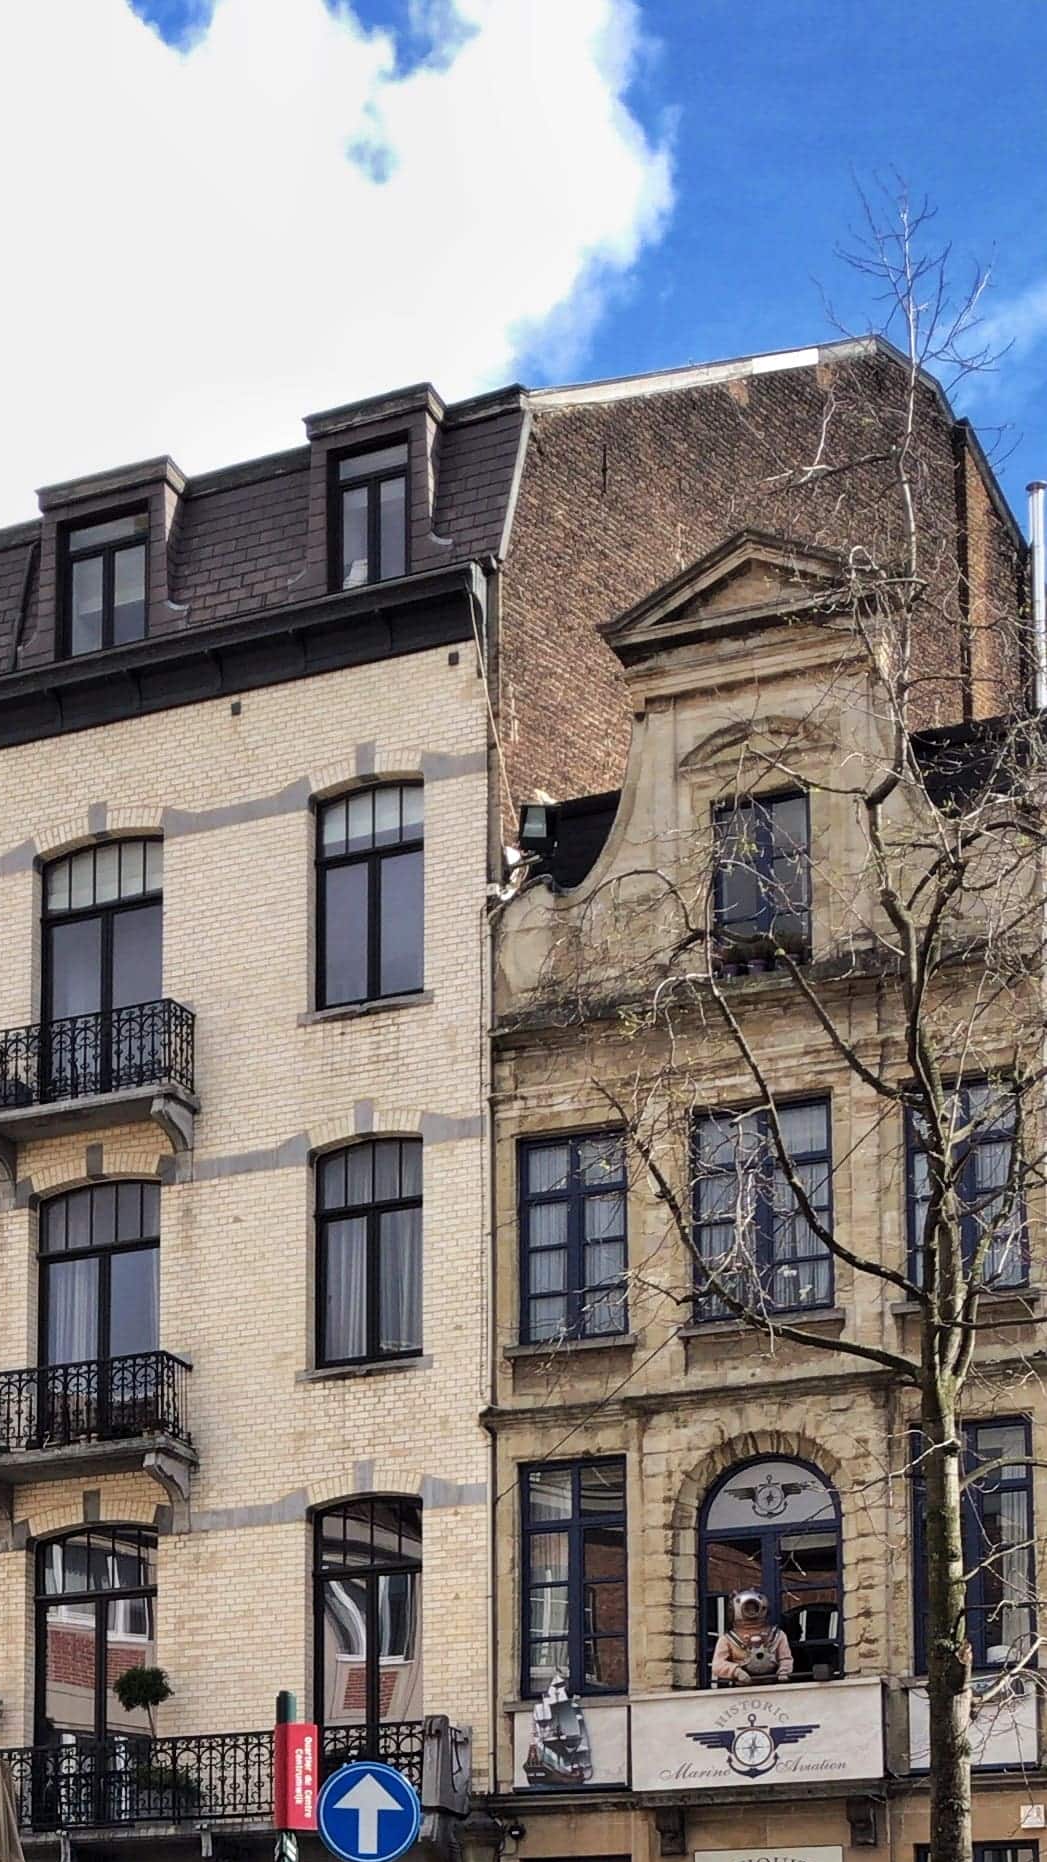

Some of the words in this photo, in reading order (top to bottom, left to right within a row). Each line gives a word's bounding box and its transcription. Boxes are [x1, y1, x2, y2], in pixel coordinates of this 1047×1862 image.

[714, 1699, 790, 1729] HISTORIC
[659, 1761, 731, 1781] Marine
[776, 1755, 847, 1773] Aviation
